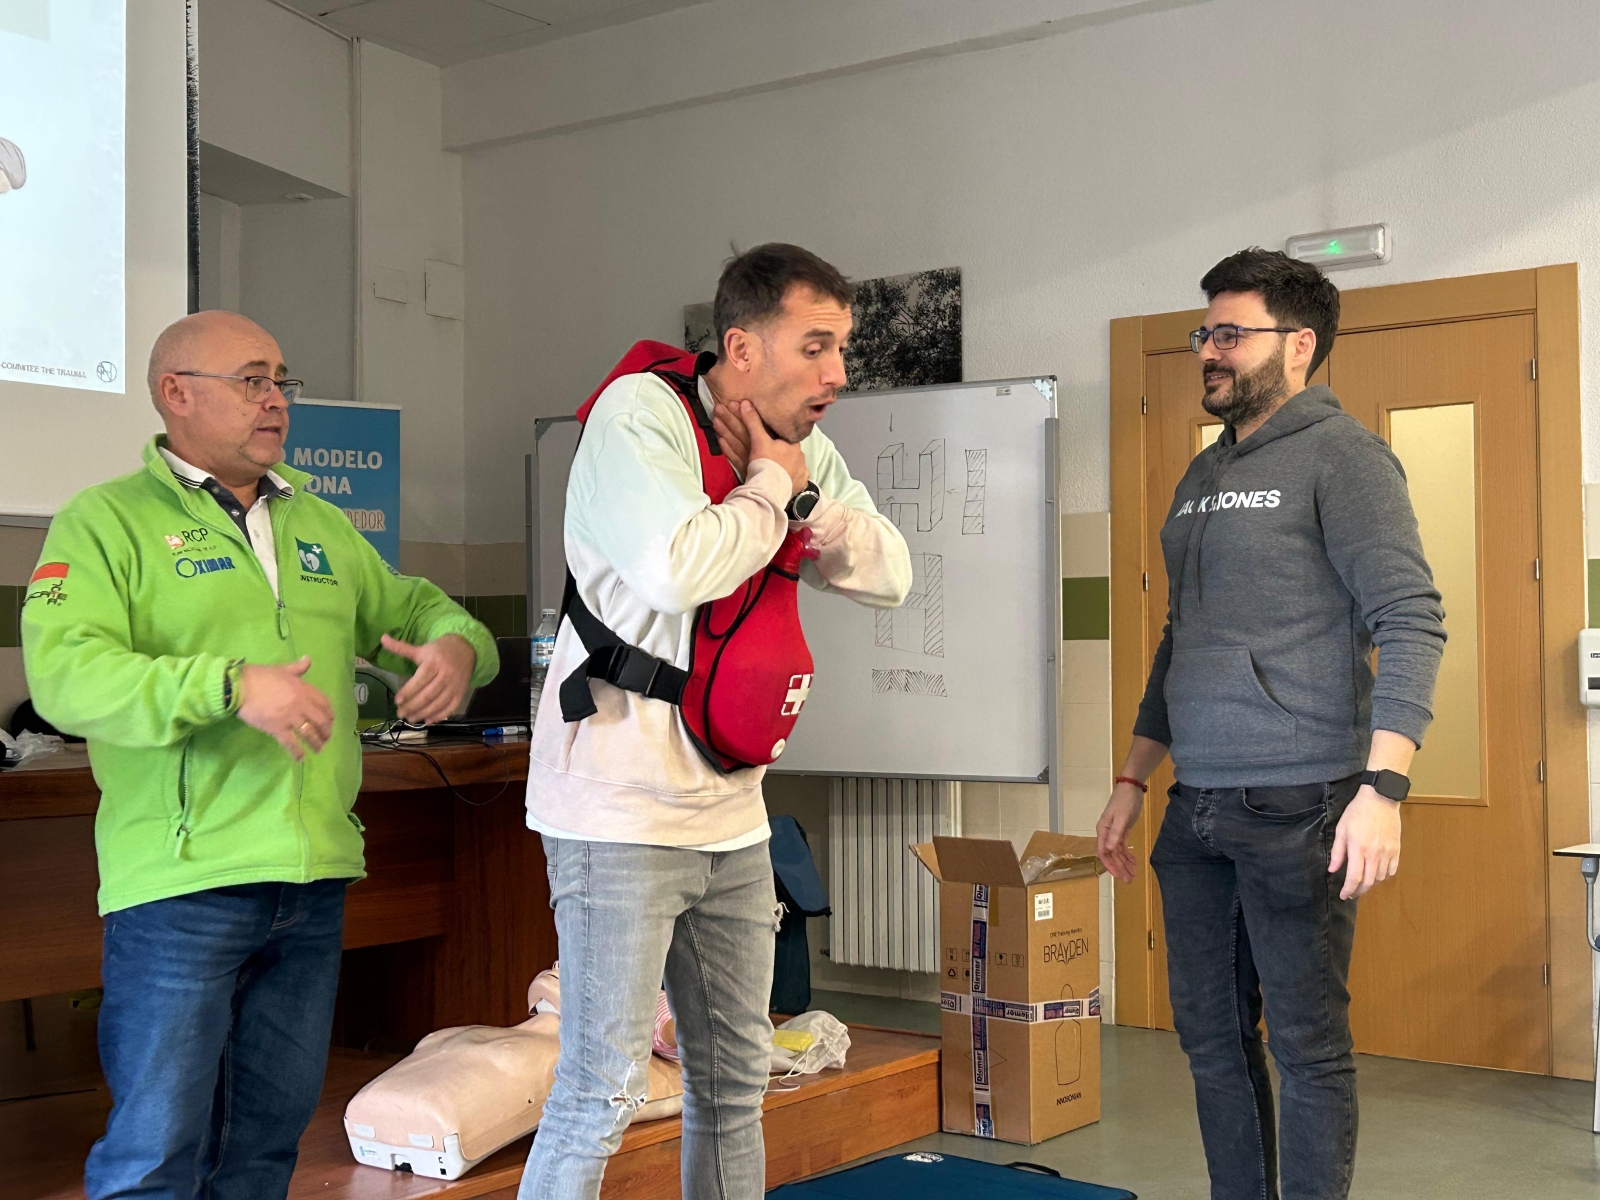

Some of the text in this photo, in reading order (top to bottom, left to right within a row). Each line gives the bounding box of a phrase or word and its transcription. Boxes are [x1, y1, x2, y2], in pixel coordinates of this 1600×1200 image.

[41, 366, 55, 375] THE
[293, 447, 383, 470] MODELO
[304, 475, 352, 495] ONA
[344, 510, 385, 530] DEDOR
[181, 527, 208, 542] RCP
[1043, 937, 1089, 965] BRAYDEN
